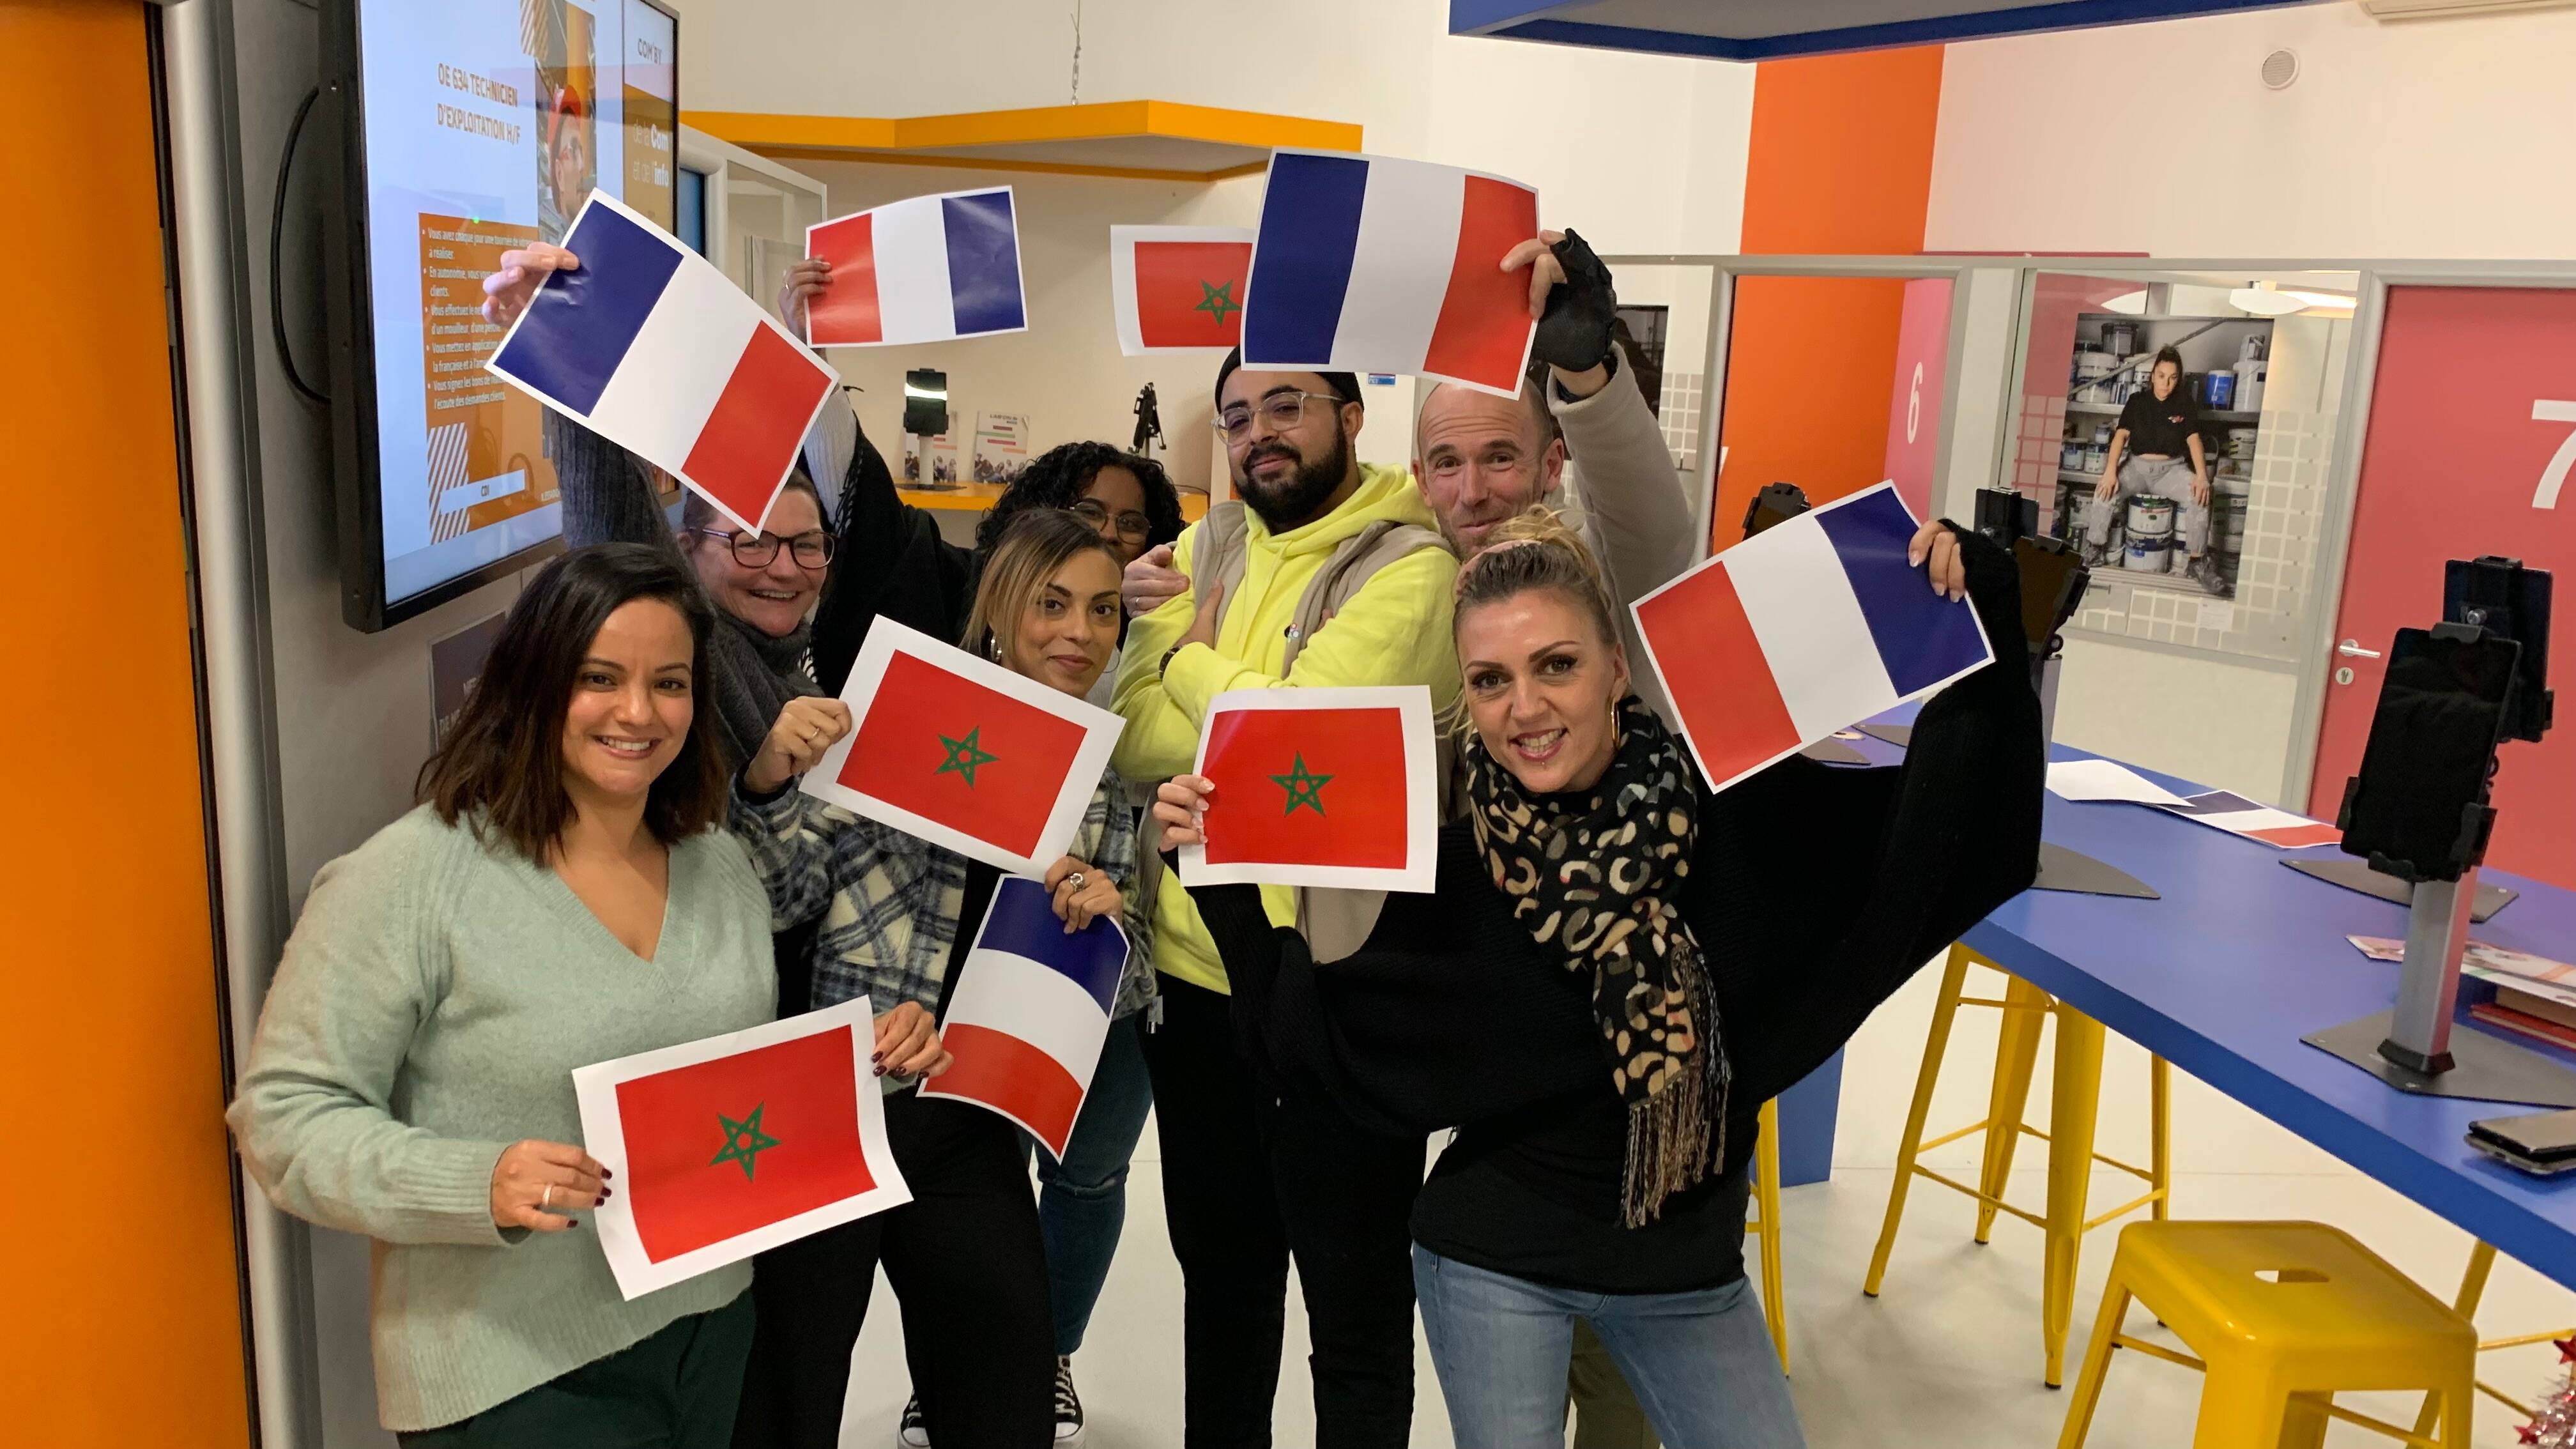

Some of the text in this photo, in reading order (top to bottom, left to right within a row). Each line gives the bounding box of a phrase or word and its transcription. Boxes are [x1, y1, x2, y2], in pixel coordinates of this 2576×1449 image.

[438, 63, 518, 107] OE 634 TECHNICIEN
[438, 103, 521, 145] D'EXPLOITATION H/F
[651, 123, 669, 152] Com
[429, 227, 441, 240] Vous
[429, 266, 436, 278] En
[431, 305, 445, 316] Vous
[433, 342, 445, 353] Vous
[439, 360, 463, 374] française
[434, 381, 447, 391] Vous
[455, 395, 464, 406] des
[465, 394, 490, 405] demandes
[1907, 362, 1923, 444] 6
[2531, 399, 2576, 509] 7
